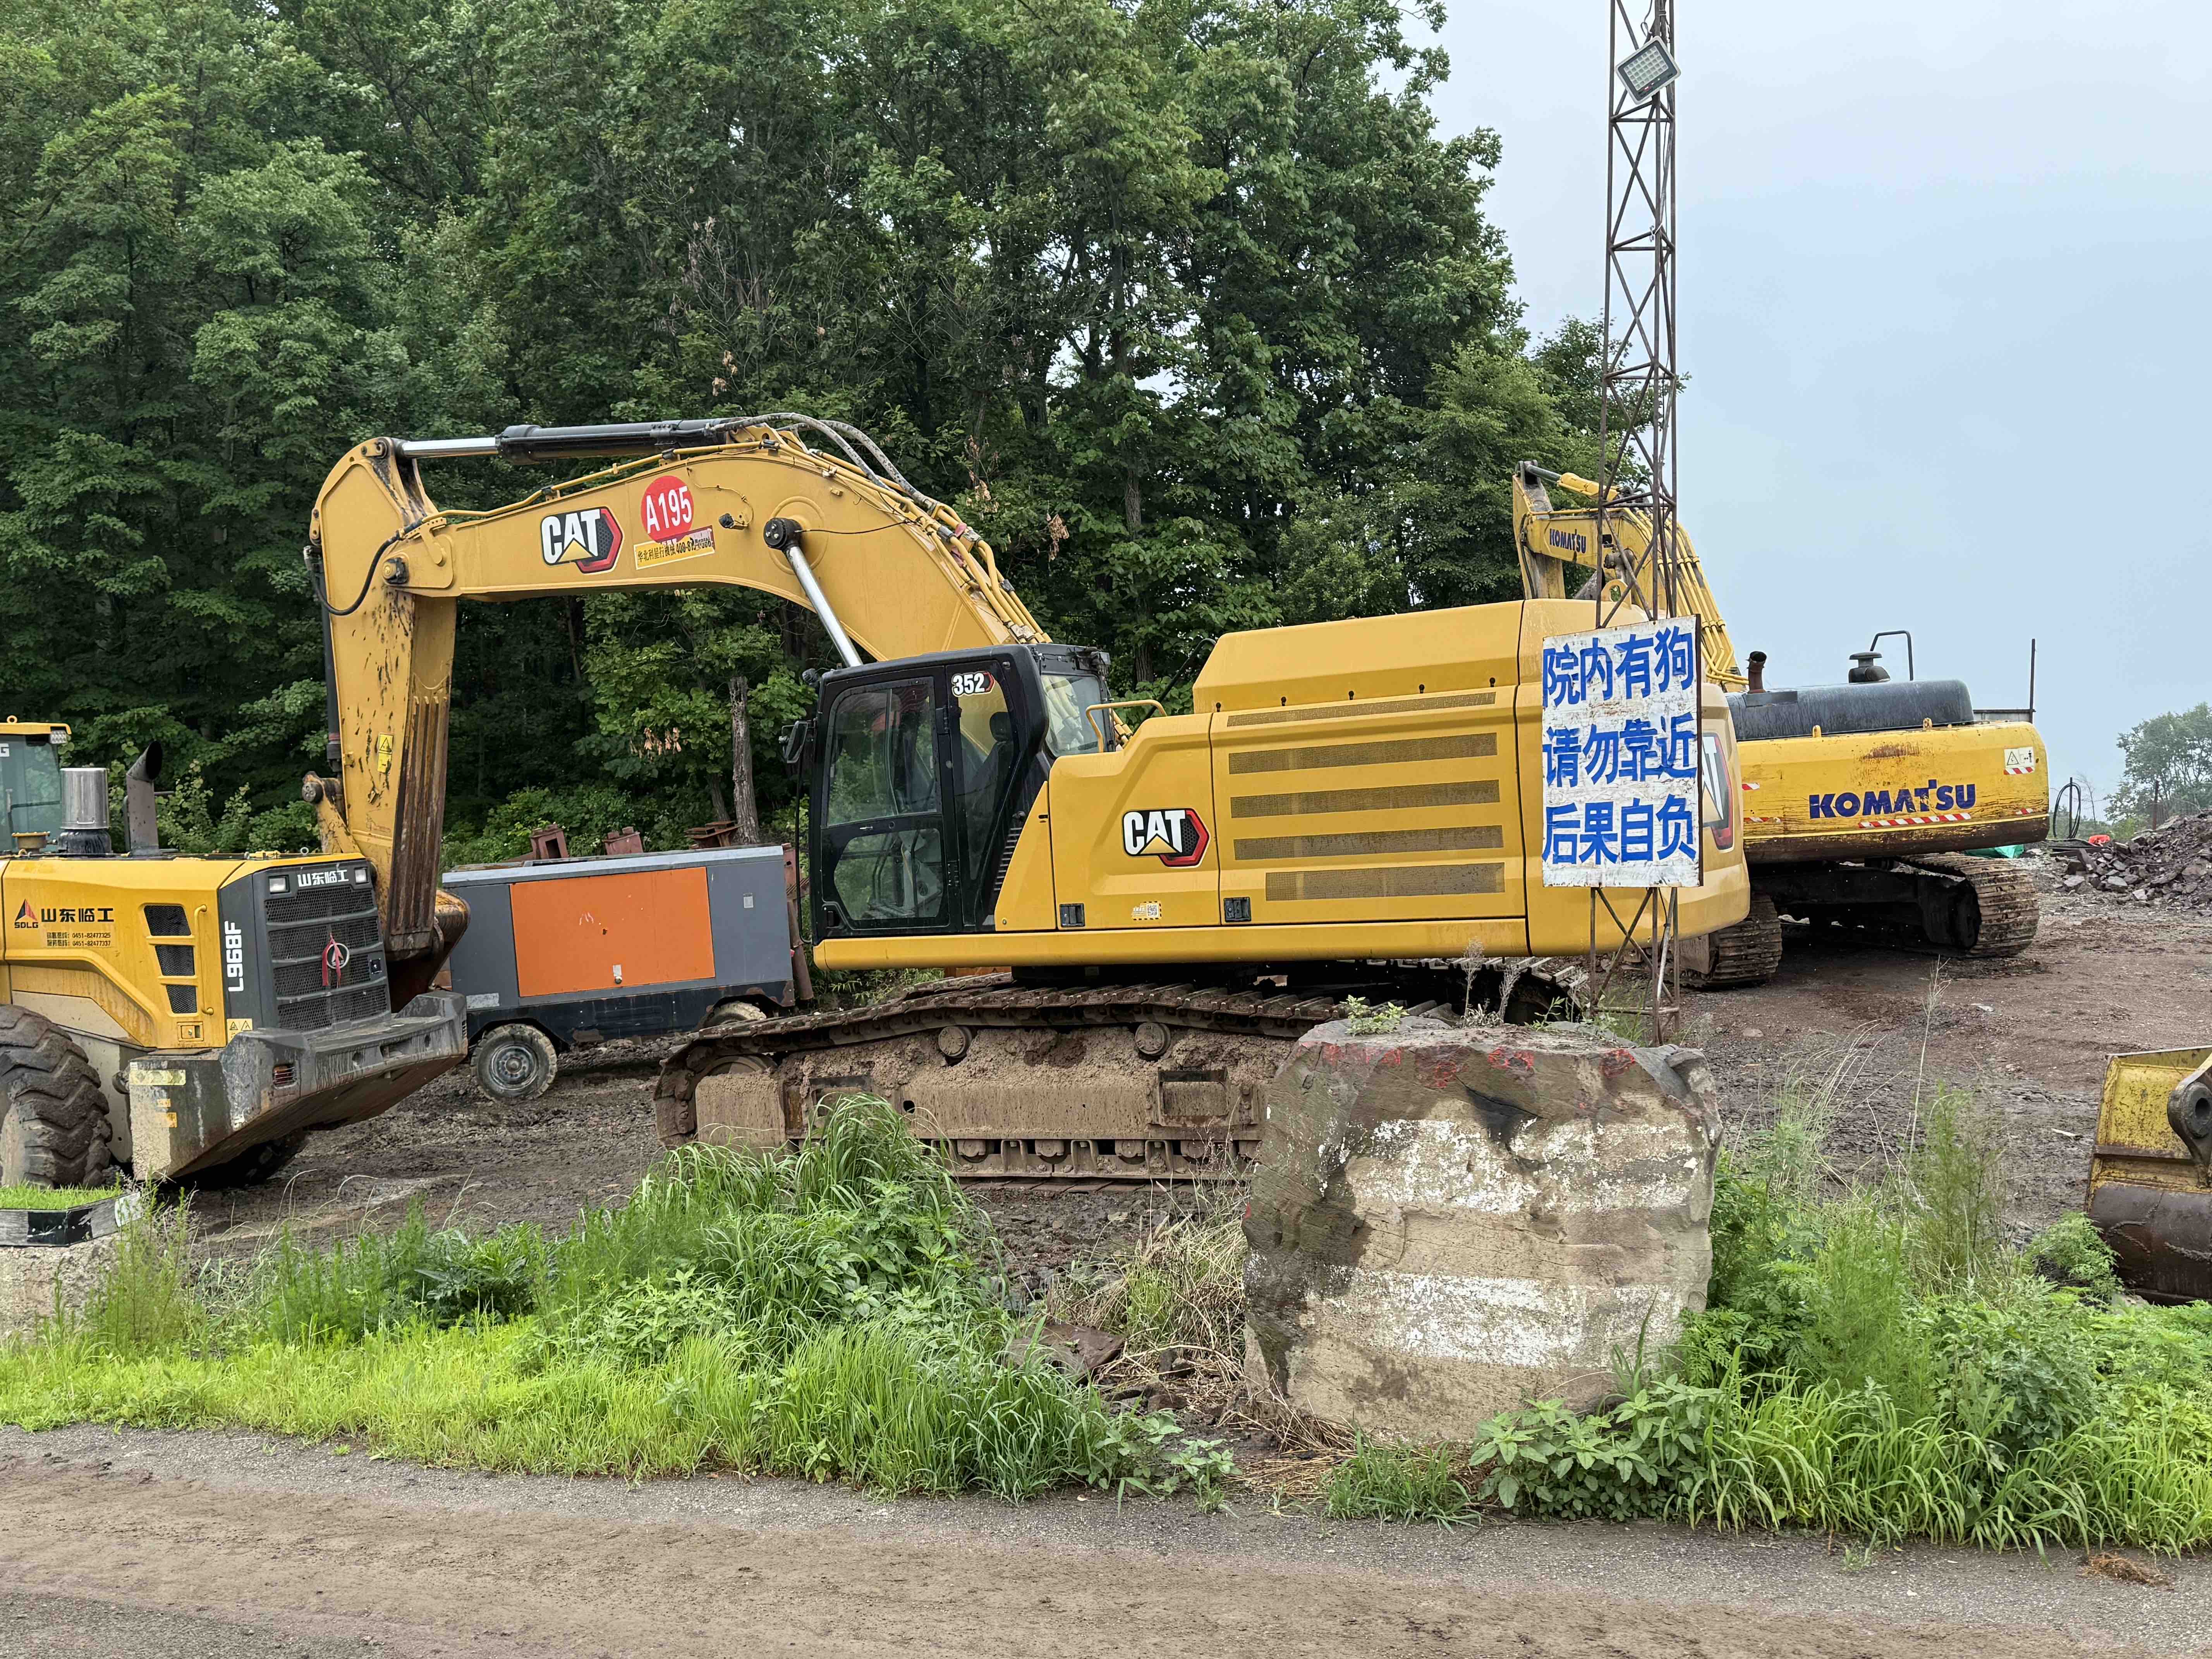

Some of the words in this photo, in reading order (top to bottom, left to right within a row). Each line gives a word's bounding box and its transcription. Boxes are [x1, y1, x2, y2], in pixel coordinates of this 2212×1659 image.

[646, 486, 692, 534] A195
[542, 508, 601, 564] CAT
[1549, 529, 1586, 553] KOMATSU
[952, 673, 985, 694] 352
[1542, 626, 1694, 707] 院内有狗
[1542, 712, 1697, 787] 请勿靠近
[1809, 779, 1976, 819] KOMATSU
[1123, 810, 1185, 855] CAT
[1542, 794, 1697, 865] 后果自负
[297, 870, 349, 887] 山东临工
[41, 908, 114, 922] 山东临工
[225, 921, 244, 992] L968F
